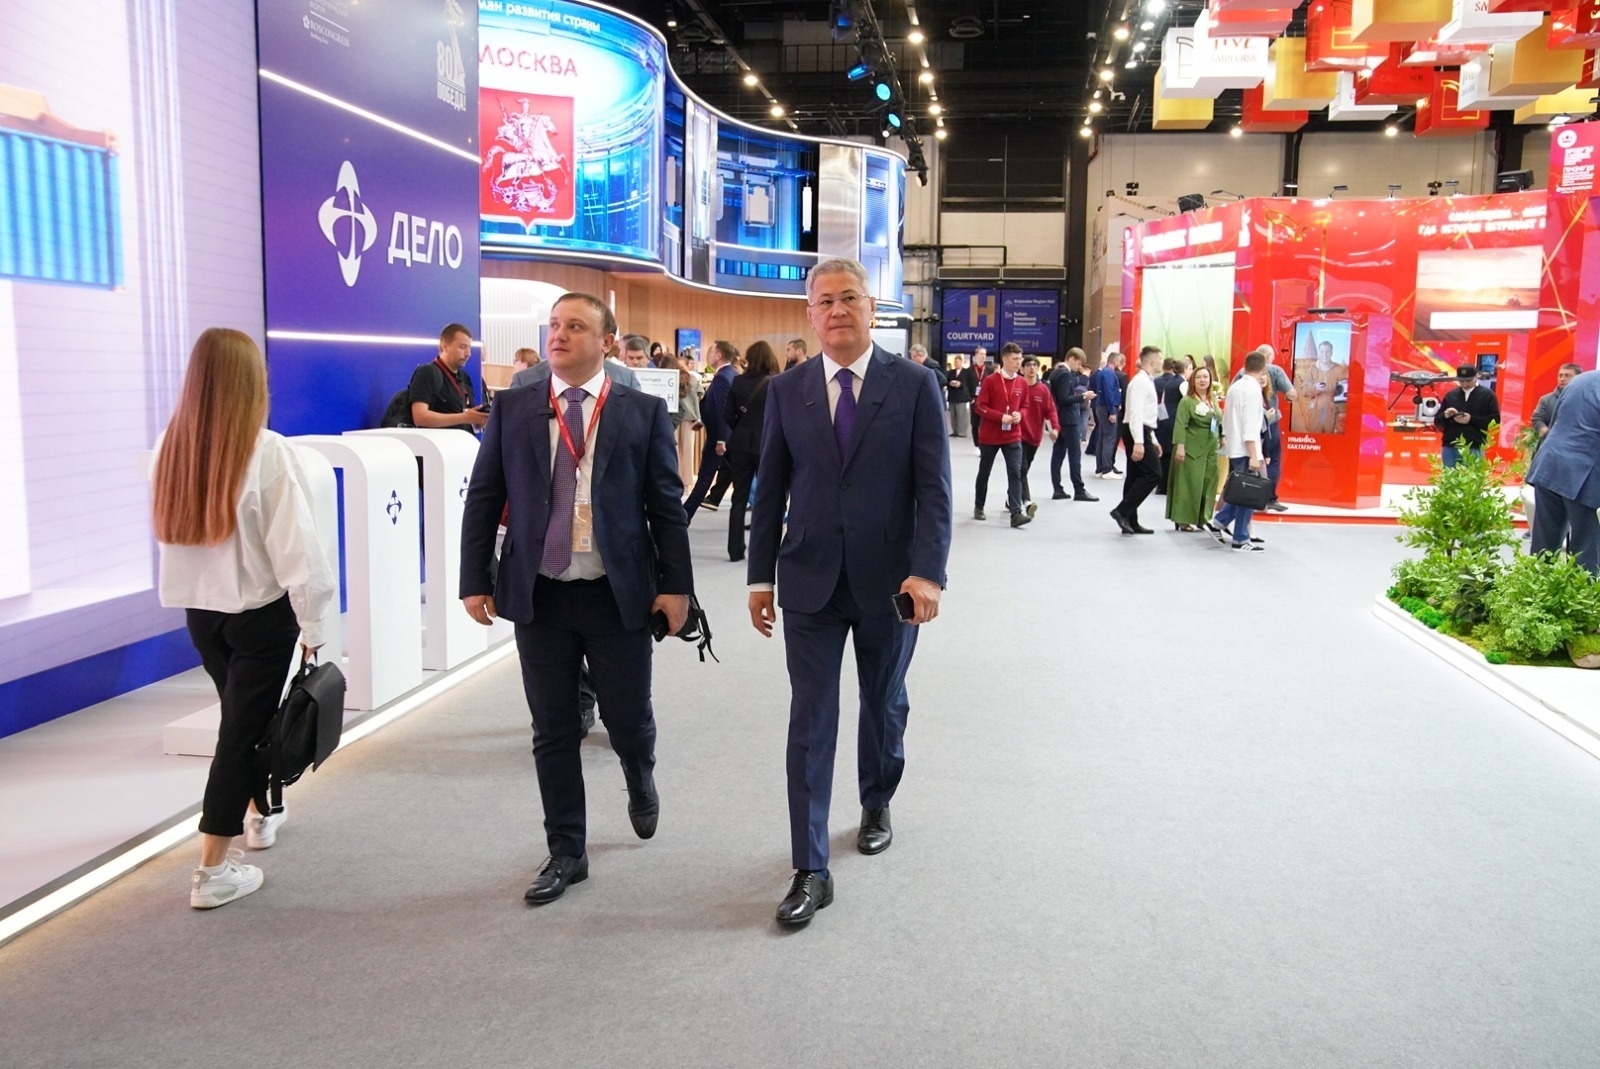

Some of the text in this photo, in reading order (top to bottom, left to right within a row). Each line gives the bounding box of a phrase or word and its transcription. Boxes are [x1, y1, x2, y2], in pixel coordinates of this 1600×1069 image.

[506, 3, 561, 22] развития
[563, 14, 601, 32] страны
[387, 211, 463, 269] ДЕЛО
[969, 295, 996, 328] H
[947, 332, 994, 340] COURTYARD
[668, 378, 674, 387] G
[667, 393, 674, 402] H
